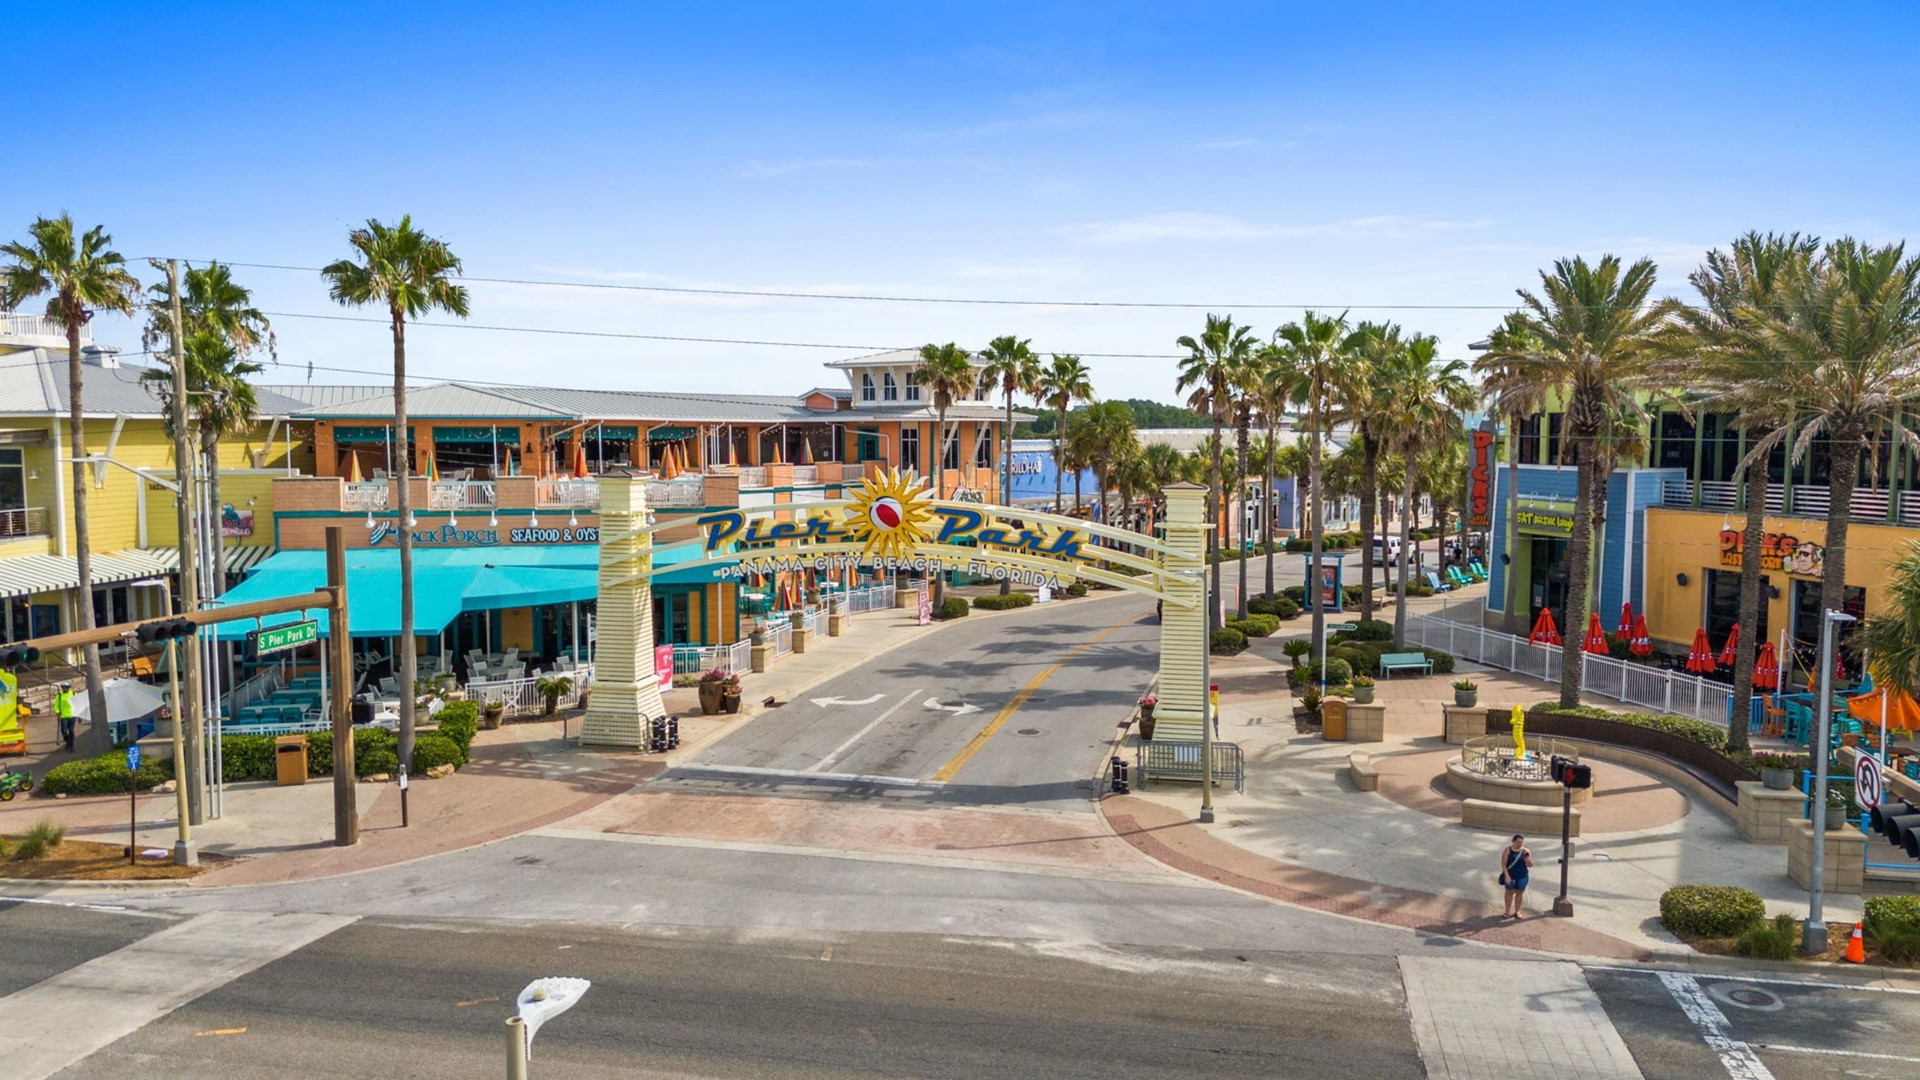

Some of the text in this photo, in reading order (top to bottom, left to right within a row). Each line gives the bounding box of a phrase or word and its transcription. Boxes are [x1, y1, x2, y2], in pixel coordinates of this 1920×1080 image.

[1001, 461, 1041, 474] CRILOHA
[1471, 430, 1493, 515] DICK'S
[1517, 512, 1533, 525] EAT
[511, 528, 560, 543] SEAFOOD
[563, 528, 573, 542] &
[697, 507, 1097, 562] Pier Park
[1719, 530, 1798, 557] DIK'S
[720, 555, 1060, 591] PANAMA CITY BEACH FLORIDA
[259, 636, 265, 649] S
[268, 634, 284, 647] Pier
[287, 629, 304, 642] Park
[307, 626, 315, 638] Dr
